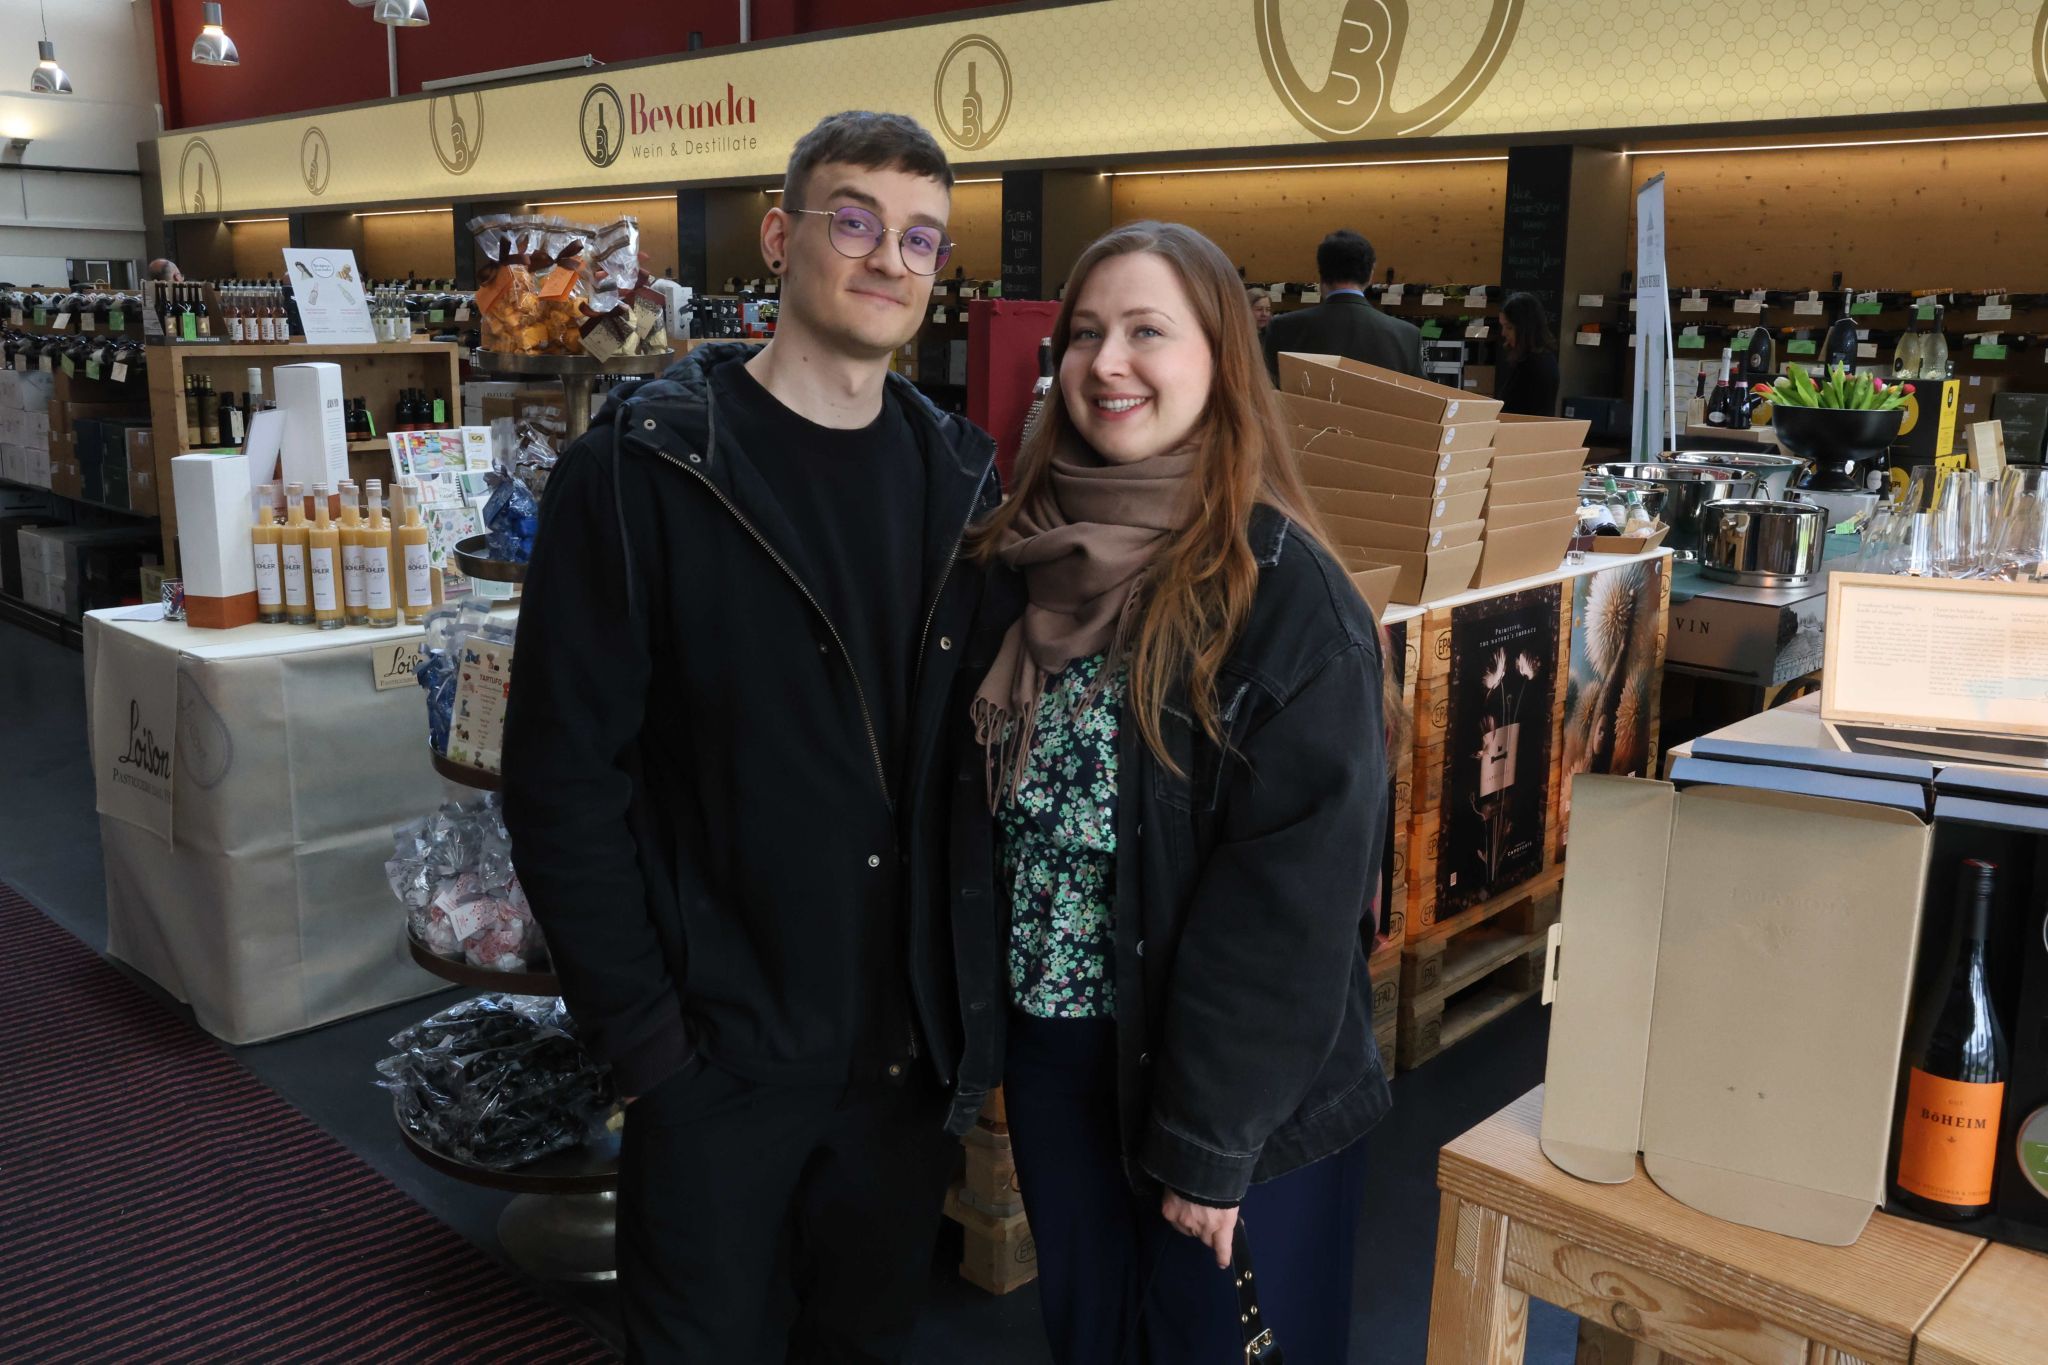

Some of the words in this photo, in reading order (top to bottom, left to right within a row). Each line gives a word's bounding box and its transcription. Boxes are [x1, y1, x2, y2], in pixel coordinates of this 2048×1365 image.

[631, 82, 756, 135] Bevanda
[632, 144, 663, 159] Wein
[670, 142, 678, 157] &
[685, 134, 757, 155] Destillate
[1675, 617, 1710, 634] VIN
[118, 699, 172, 780] Loison
